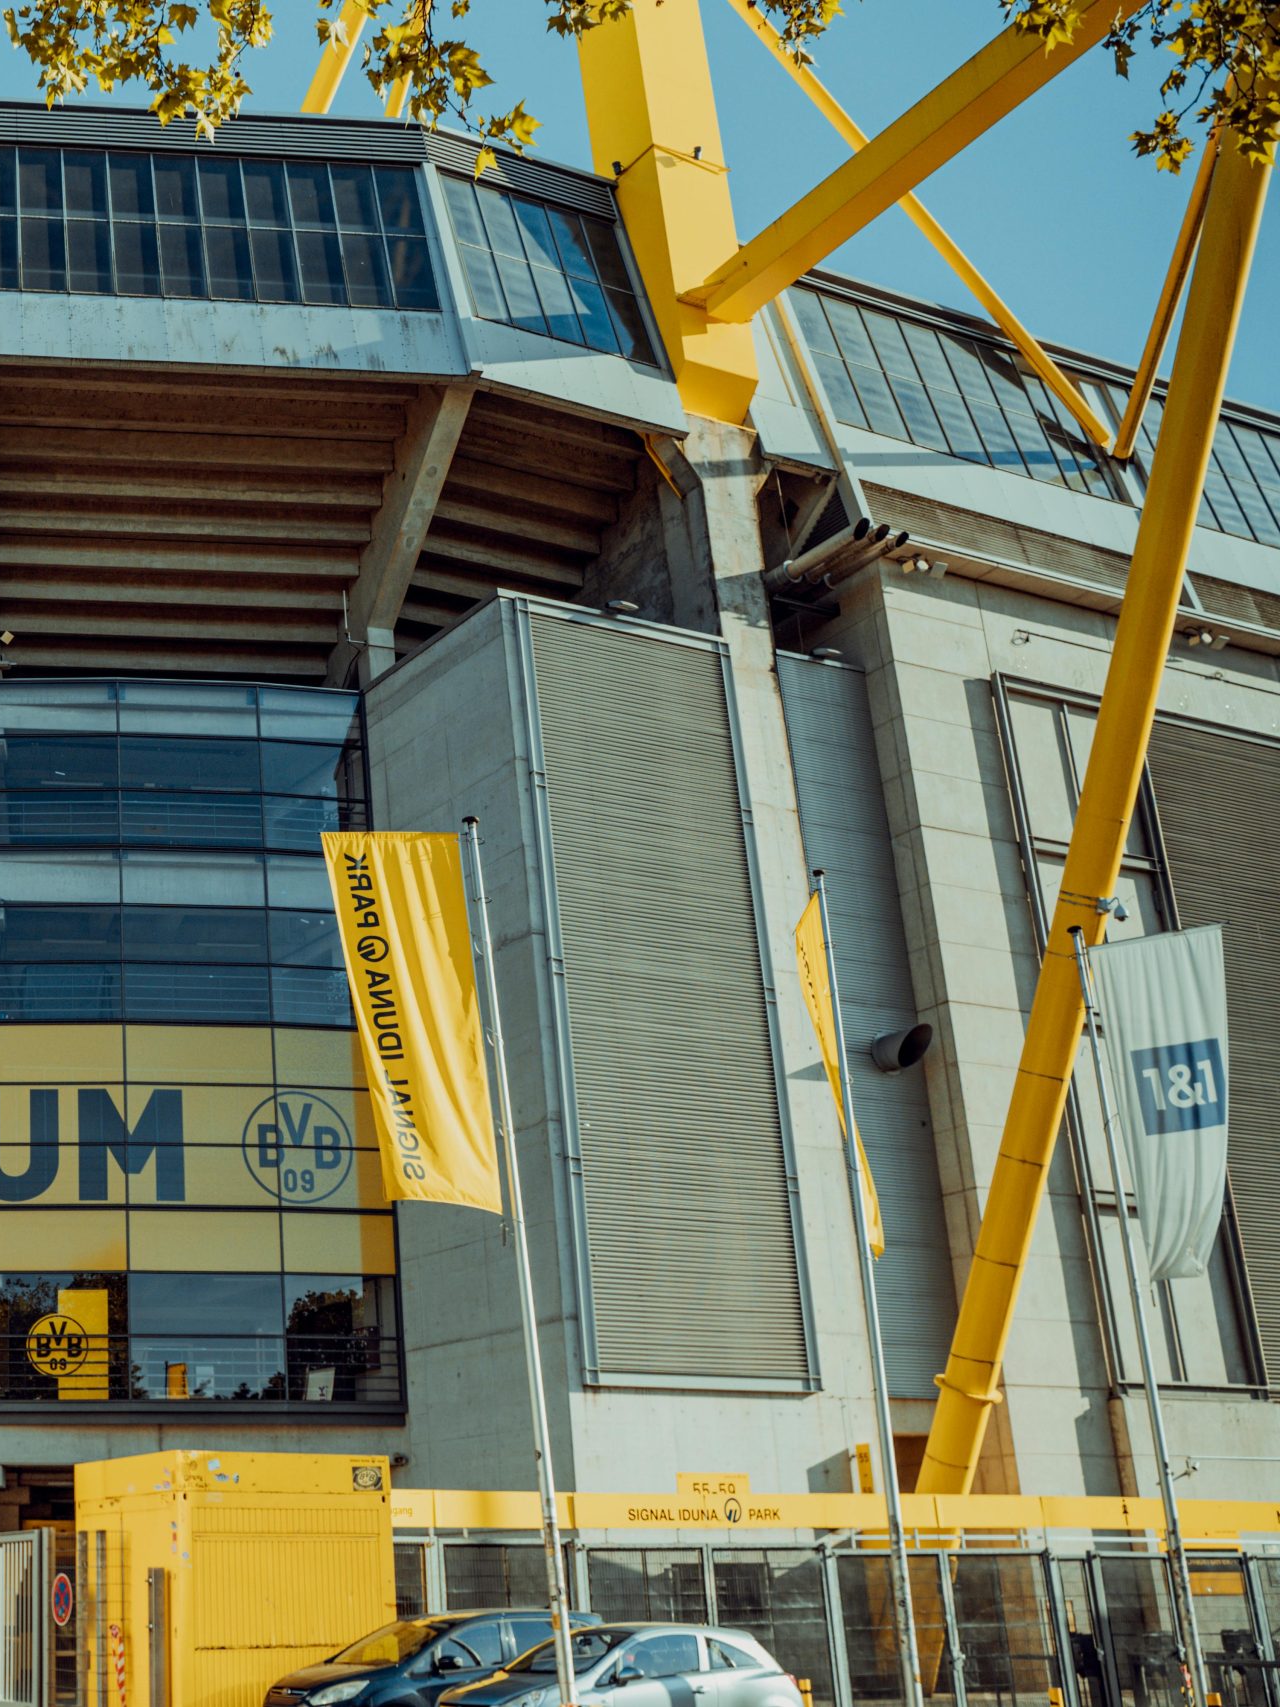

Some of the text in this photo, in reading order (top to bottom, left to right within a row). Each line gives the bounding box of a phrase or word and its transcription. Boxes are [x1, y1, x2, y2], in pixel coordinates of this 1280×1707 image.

[1142, 1059, 1218, 1110] 1&1
[257, 1102, 342, 1170] BVB
[283, 1168, 315, 1193] 09
[36, 1321, 83, 1358] BVB
[628, 1508, 780, 1522] SIGNAL IDUNA PARK
